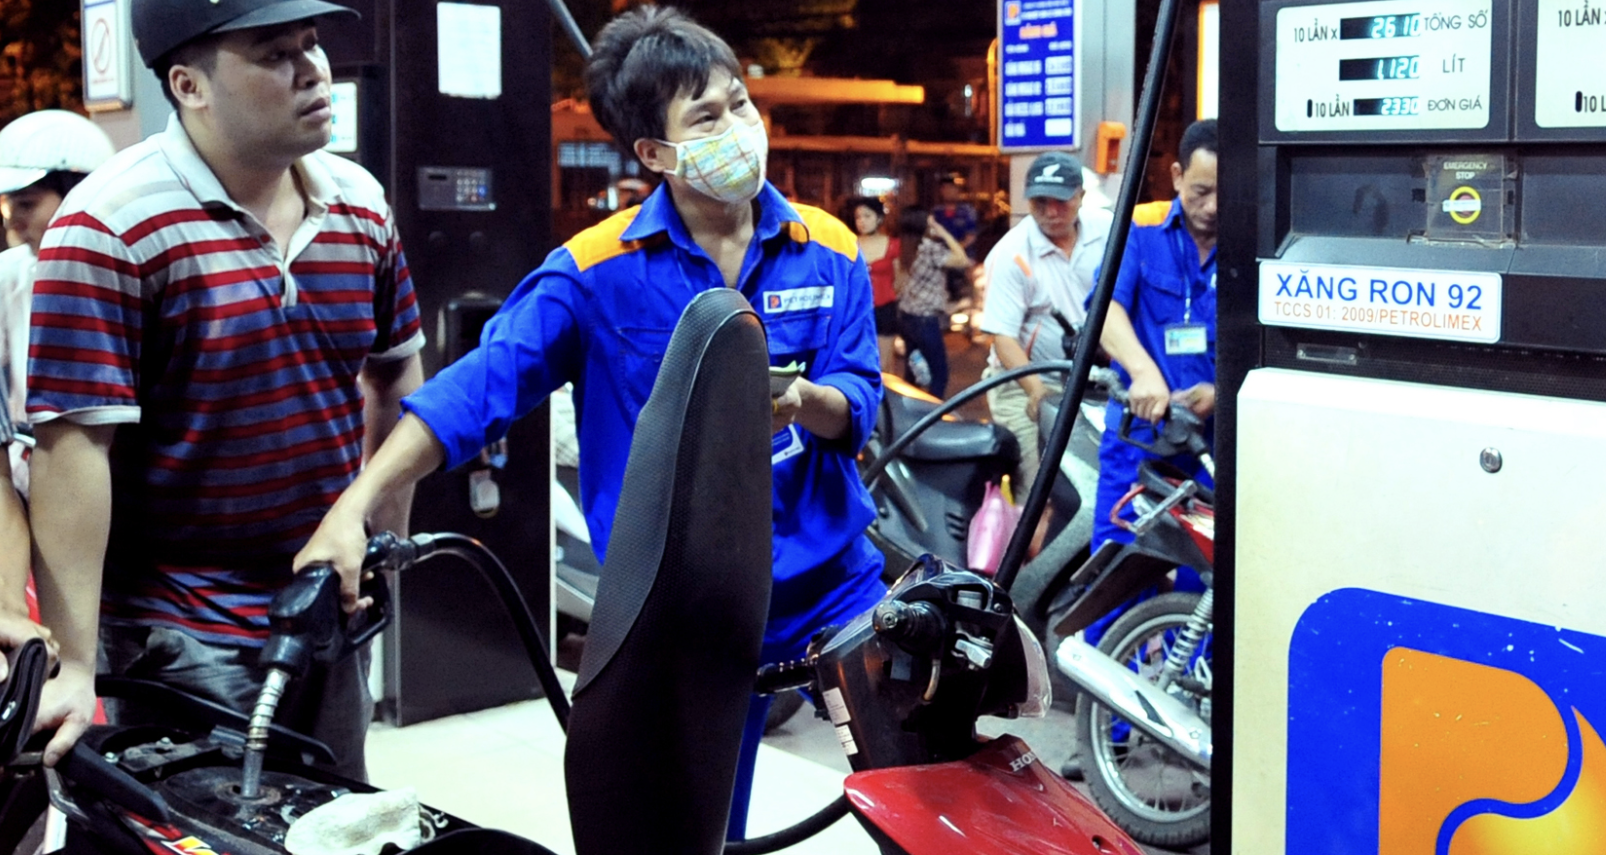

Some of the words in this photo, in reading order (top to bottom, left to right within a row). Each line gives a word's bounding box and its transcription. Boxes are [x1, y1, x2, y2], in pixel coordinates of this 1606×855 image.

[1294, 27, 1304, 43] 10
[1371, 15, 1420, 39] 2610
[1468, 9, 1489, 29] SỐ
[1558, 9, 1572, 27] 10
[1442, 53, 1466, 73] LÍT
[1315, 102, 1326, 118] 10
[1381, 97, 1420, 115] 2330
[1459, 94, 1483, 111] GIÁ
[1583, 95, 1597, 113] 10
[1443, 161, 1487, 170] EMERGENCY
[1455, 171, 1475, 179] STOP
[1275, 268, 1358, 302] XĂNG
[1370, 278, 1436, 307] RON
[1447, 283, 1482, 310] 92
[1274, 301, 1312, 318] TCCS
[1341, 306, 1483, 332] 2009/PETROLIMEX
